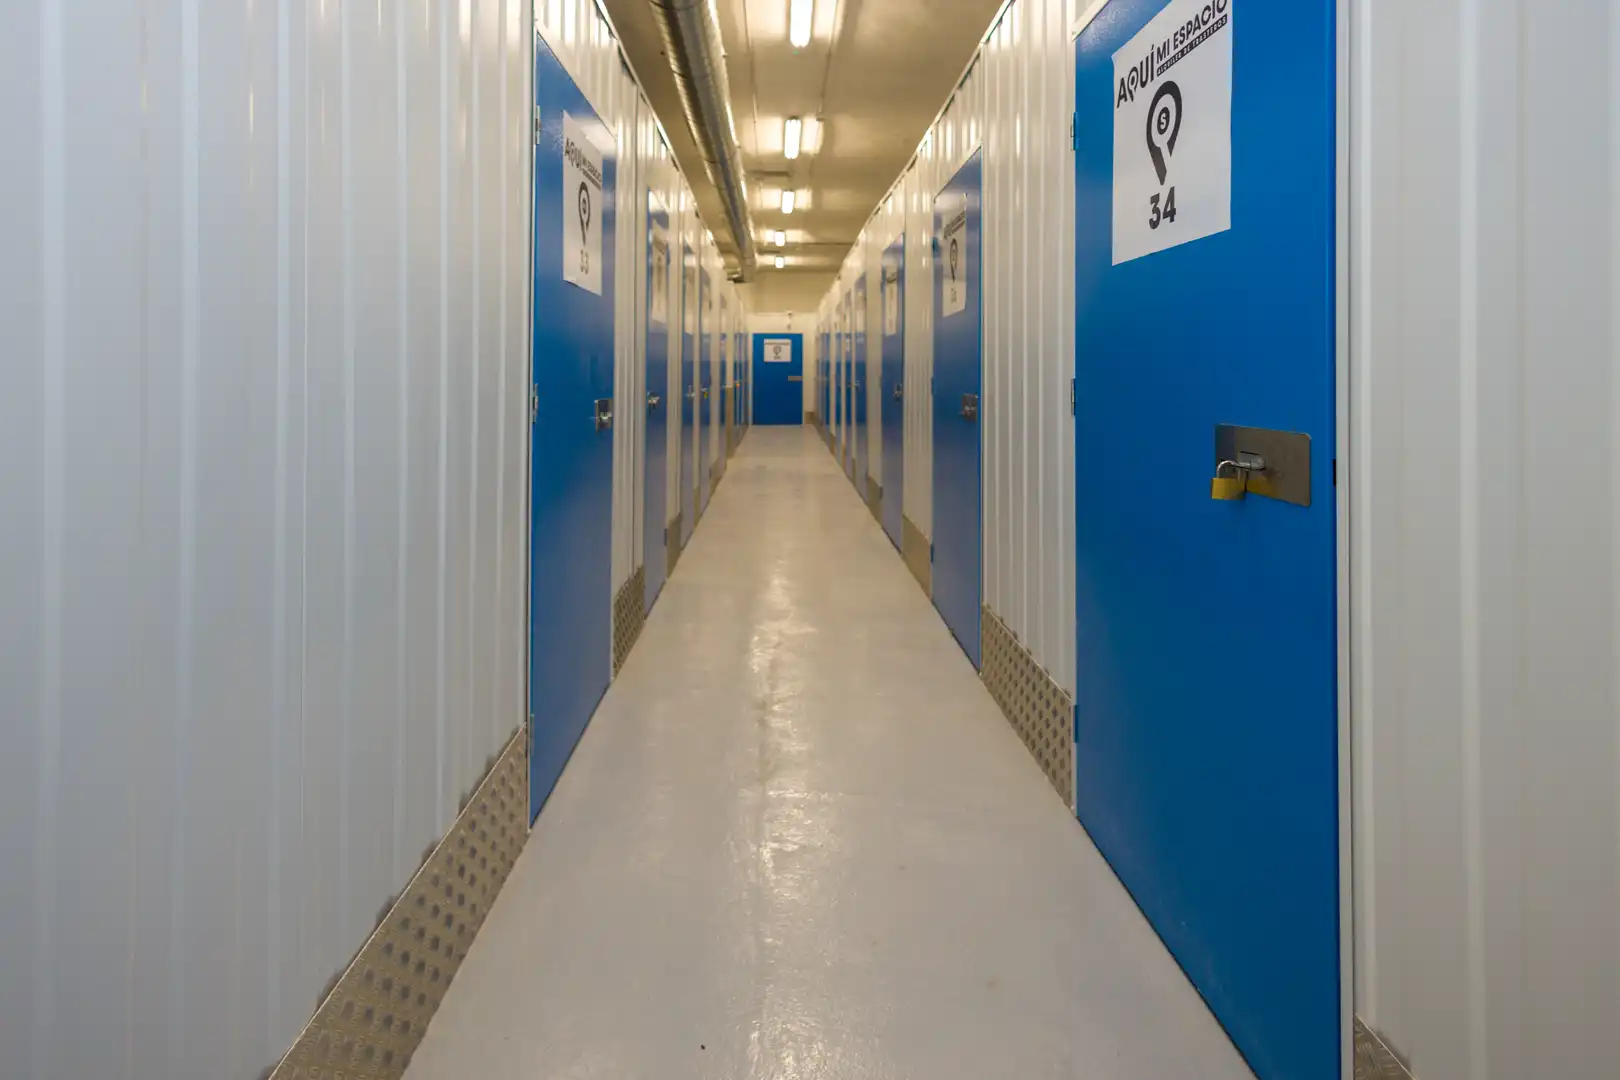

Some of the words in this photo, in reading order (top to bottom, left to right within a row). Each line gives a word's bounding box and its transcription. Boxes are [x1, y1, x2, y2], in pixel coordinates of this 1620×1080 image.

[1117, 44, 1155, 109] AQUÍ
[1157, 39, 1170, 64] MI
[1173, 0, 1228, 50] ESPACIO
[1183, 44, 1191, 55] DE
[1192, 16, 1227, 48] TRASTEROS
[1148, 186, 1177, 230] 34
